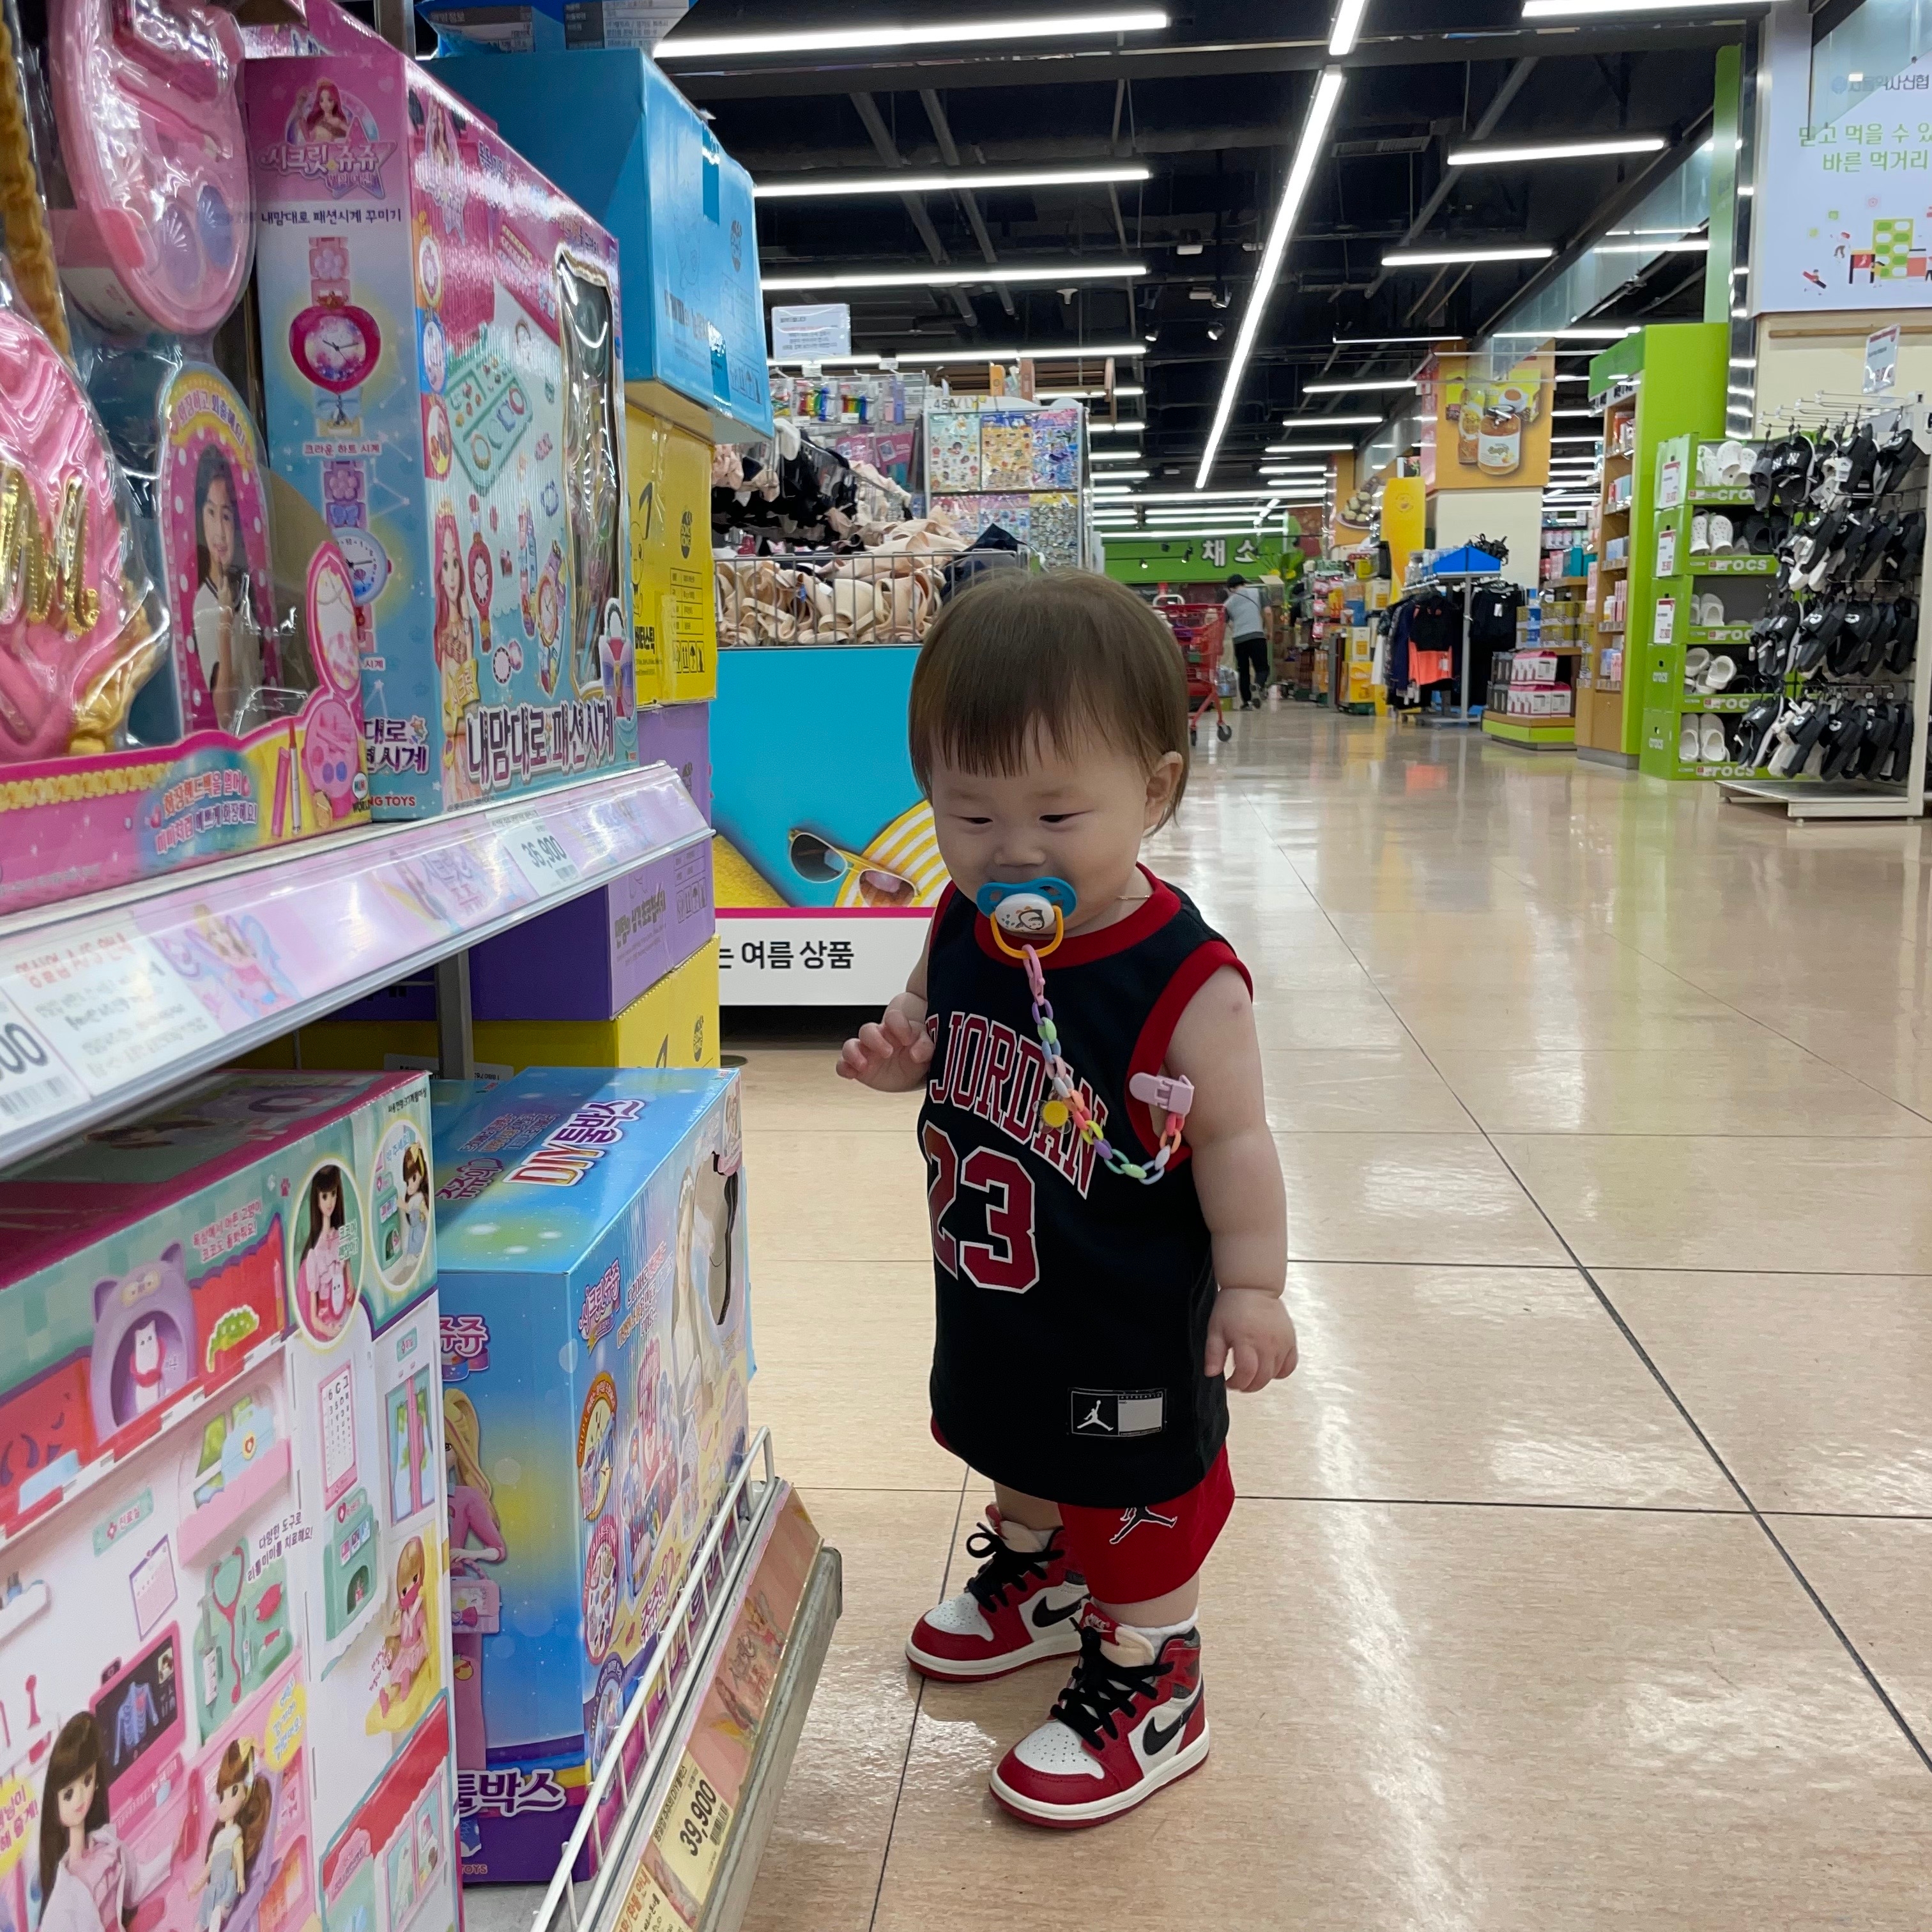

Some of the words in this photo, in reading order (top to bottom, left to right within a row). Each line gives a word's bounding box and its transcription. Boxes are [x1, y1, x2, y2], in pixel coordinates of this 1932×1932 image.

[1798, 125, 1837, 147] 믿고
[1845, 123, 1883, 145] 먹을
[1891, 123, 1910, 143] 수
[1823, 152, 1862, 172] 바른
[1870, 149, 1928, 171] 먹거리
[262, 209, 310, 226] 내맘대로
[314, 208, 362, 225] 패션시계
[365, 208, 401, 224] 꾸미기
[467, 704, 548, 785] 내맘대로
[551, 700, 615, 768] 패션시계
[385, 796, 415, 806] TOYS
[521, 834, 567, 870] 36,900
[742, 940, 794, 970] 여름
[799, 940, 855, 970] 상품
[930, 1011, 1108, 1200] JORDAN
[922, 1120, 1040, 1294] 23
[259, 1523, 280, 1549] 다양한
[282, 1512, 301, 1533] 도구로
[680, 1779, 716, 1857] 39,900
